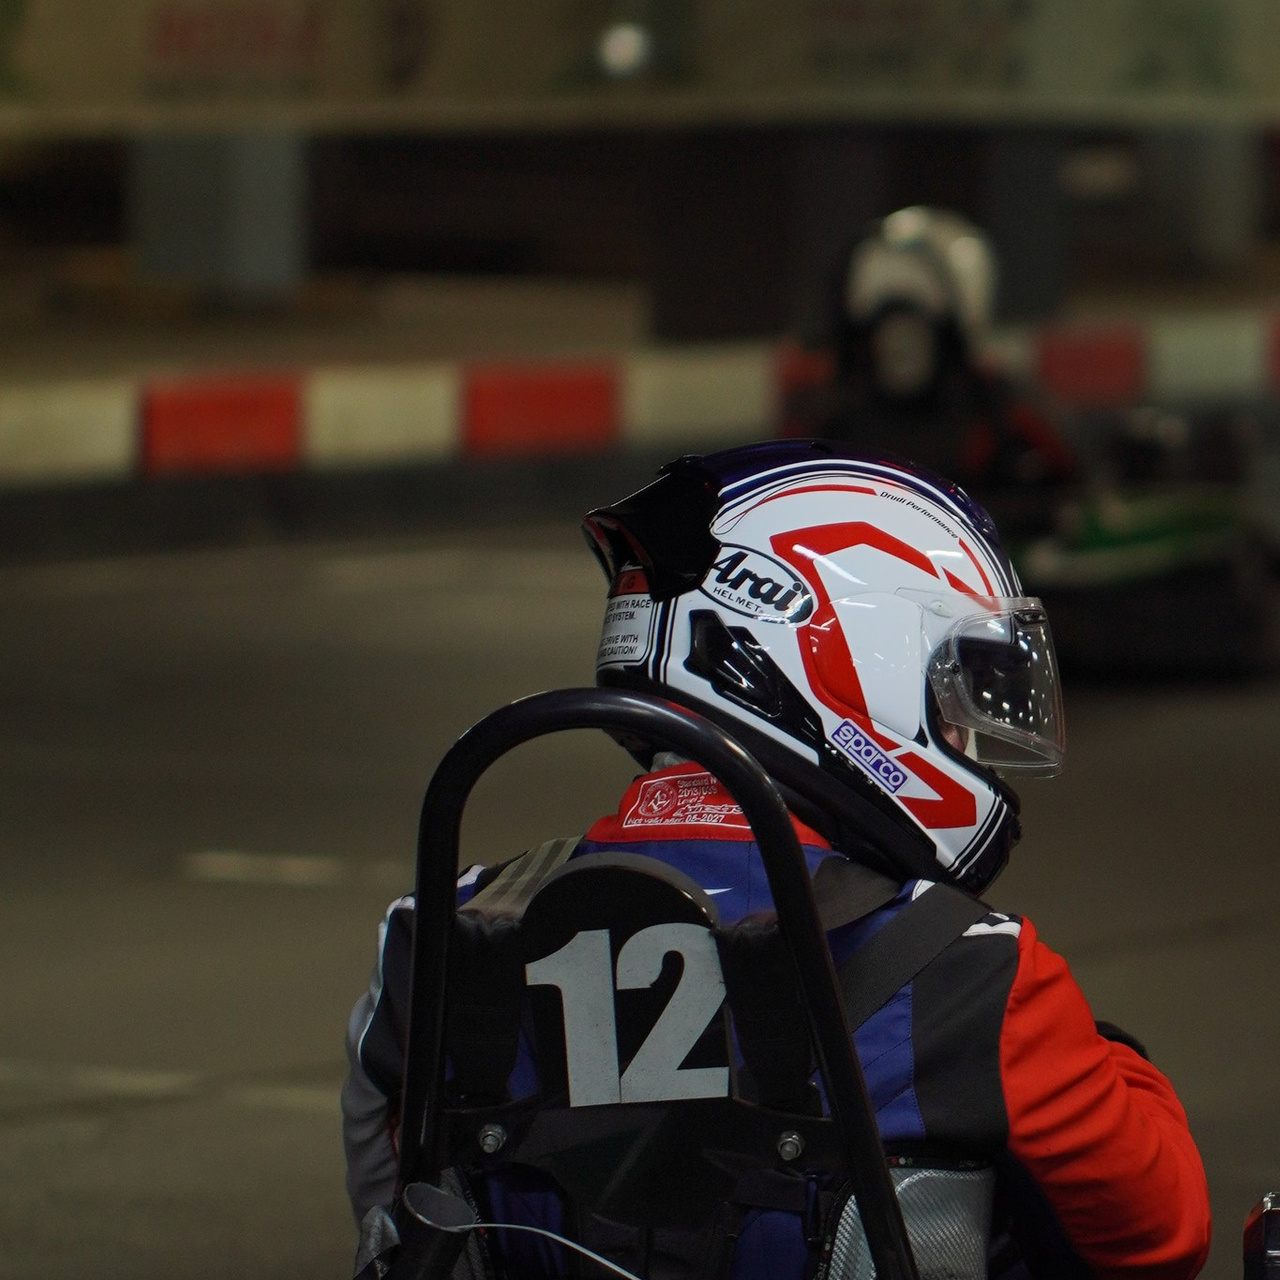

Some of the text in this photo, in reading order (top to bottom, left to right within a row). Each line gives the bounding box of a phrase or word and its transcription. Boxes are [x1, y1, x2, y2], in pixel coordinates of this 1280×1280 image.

[906, 501, 959, 539] Performance
[711, 551, 803, 612] Arai
[713, 586, 762, 613] HELMET
[630, 599, 652, 609] RACE
[620, 634, 639, 644] WITH
[834, 725, 904, 793] sparco
[525, 923, 729, 1107] 12
